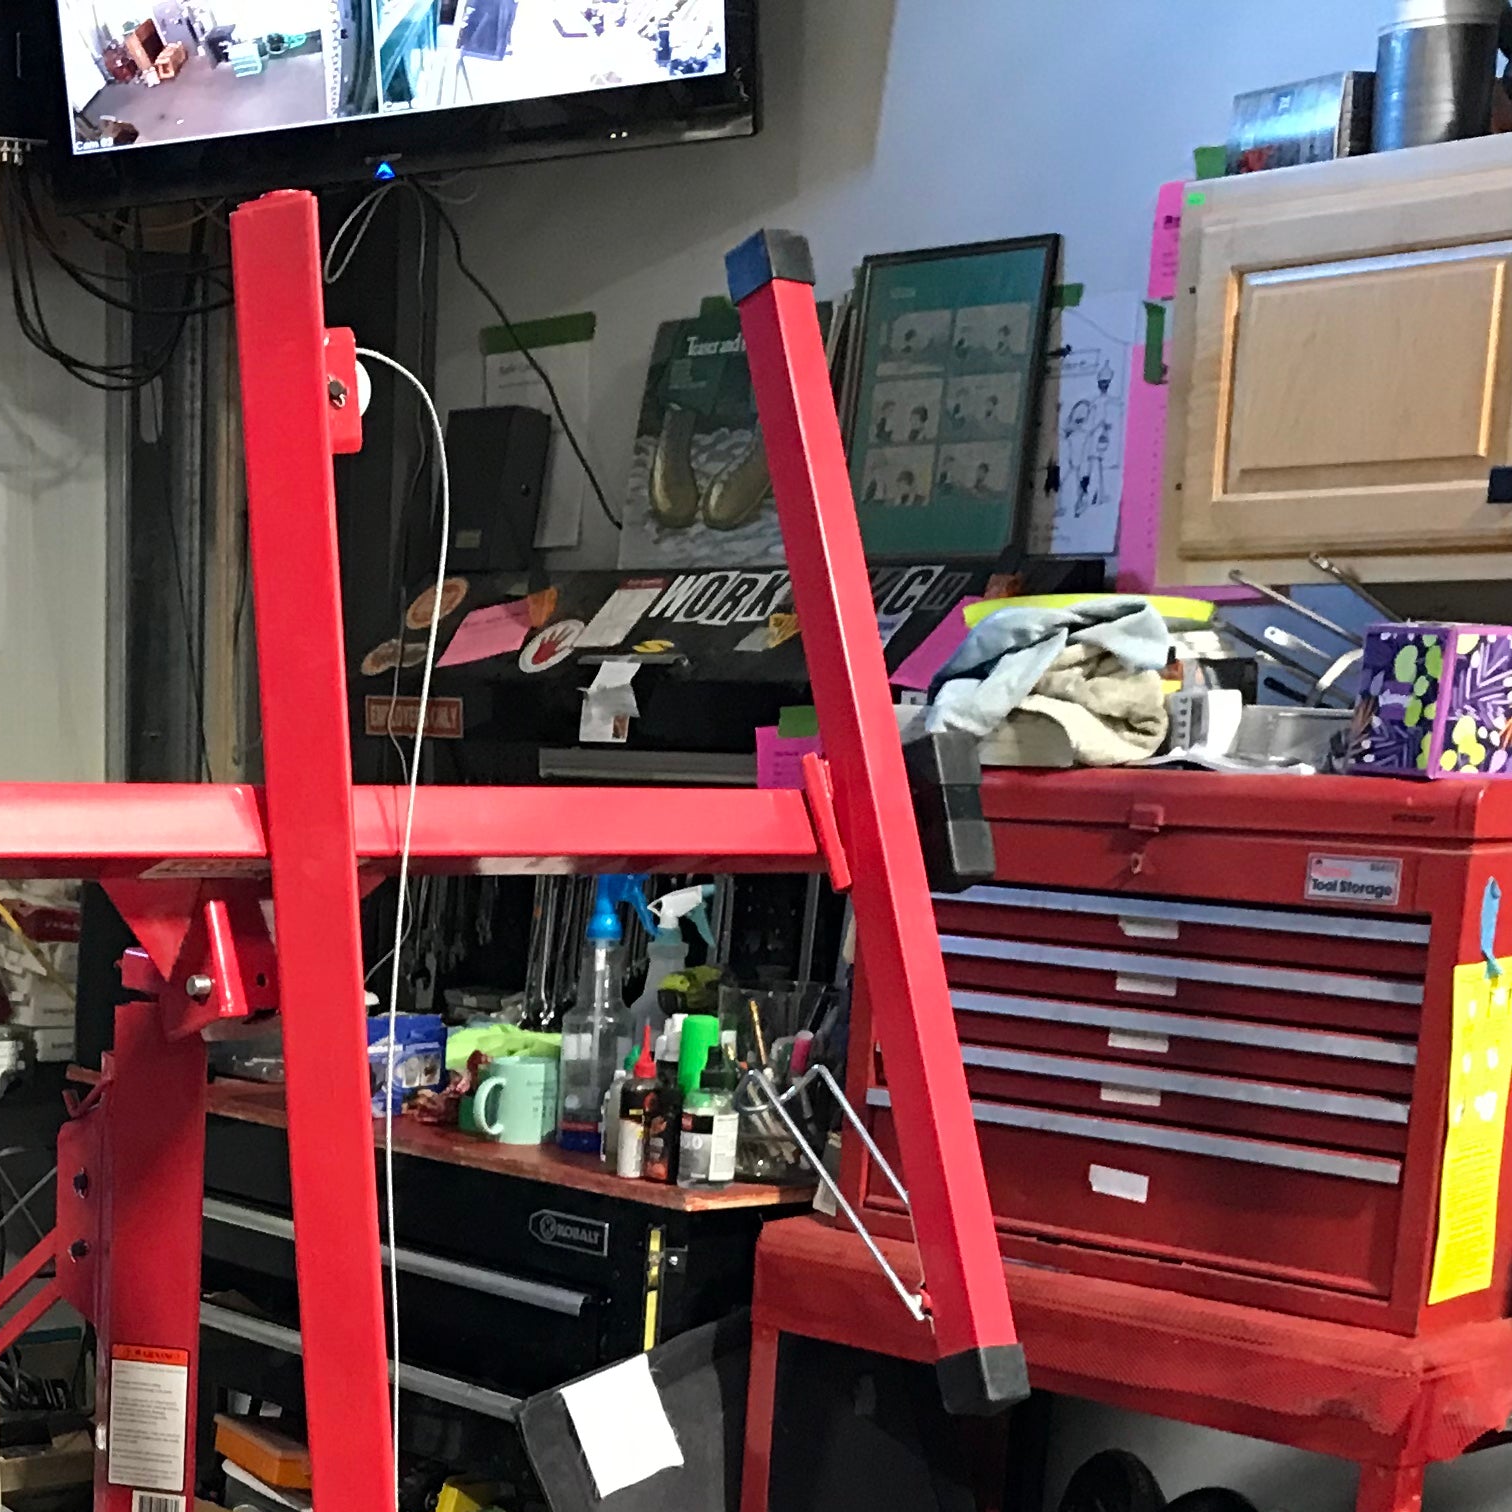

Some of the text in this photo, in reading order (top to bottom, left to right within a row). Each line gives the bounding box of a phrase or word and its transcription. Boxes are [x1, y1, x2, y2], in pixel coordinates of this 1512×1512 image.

[720, 332, 742, 352] and
[1312, 879, 1393, 898] Tool Storage
[556, 1223, 601, 1245] KOBALT
